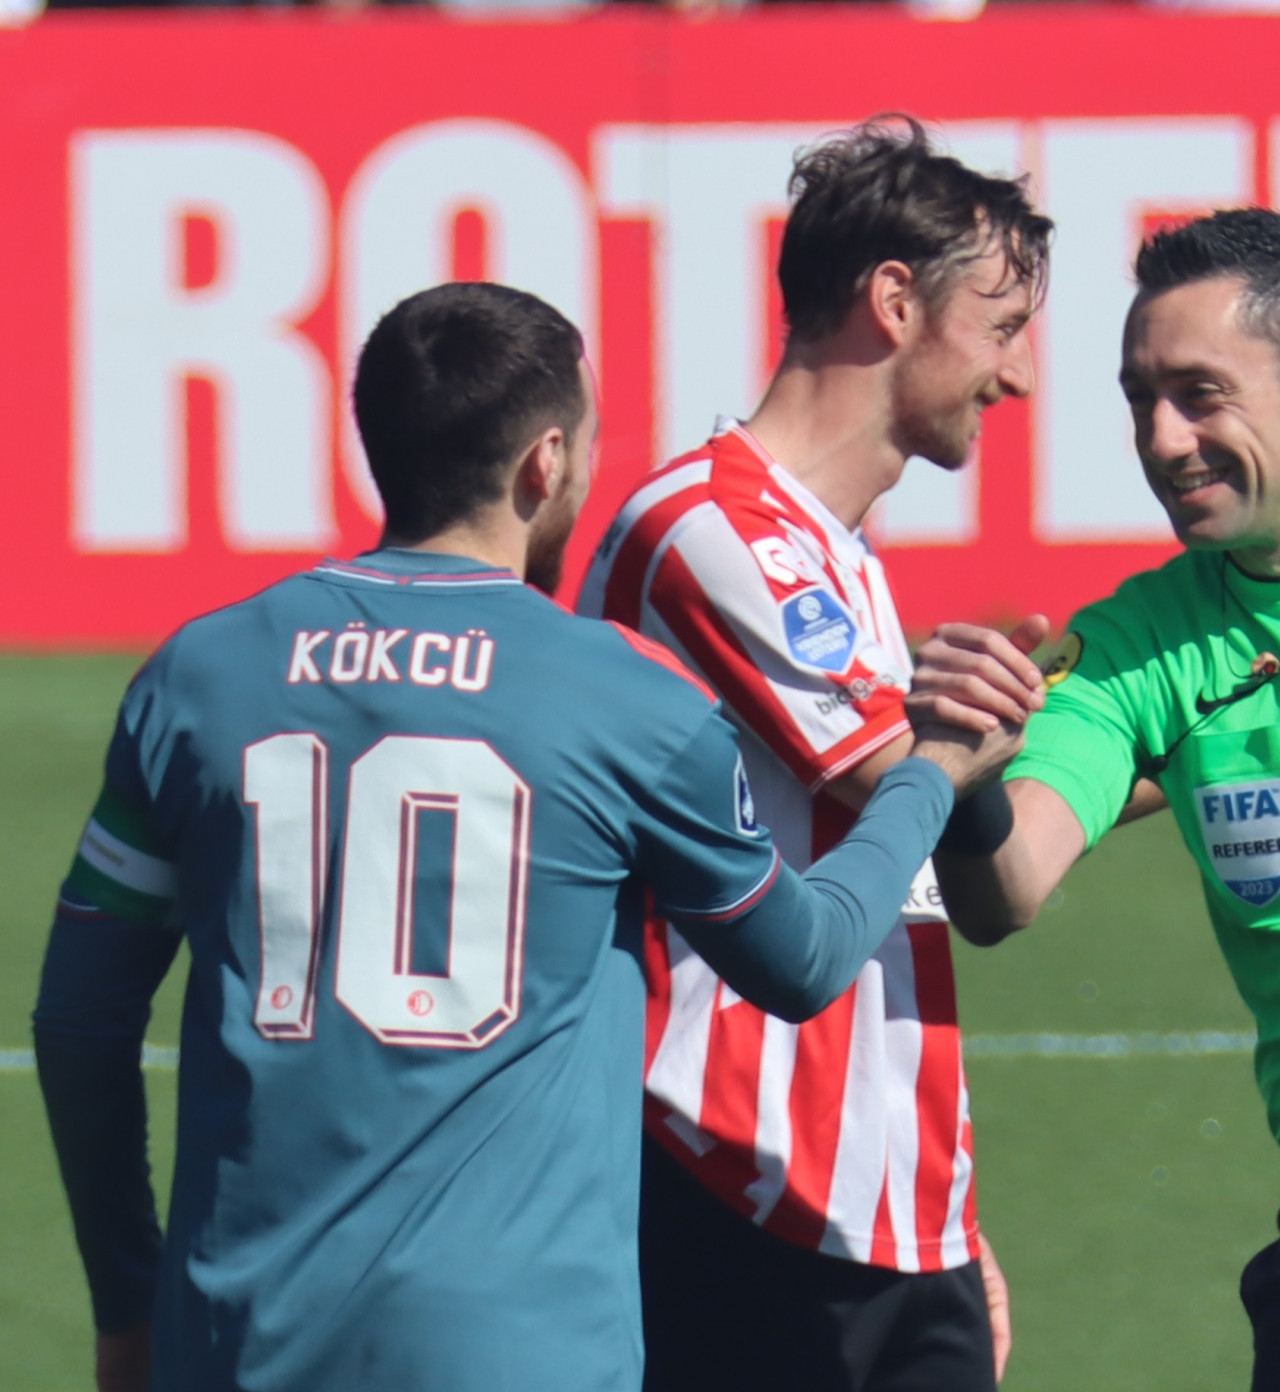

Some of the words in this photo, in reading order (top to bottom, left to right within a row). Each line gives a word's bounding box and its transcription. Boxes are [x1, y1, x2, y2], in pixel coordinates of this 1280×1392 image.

[287, 621, 495, 692] KÖKCÜ
[243, 731, 532, 1049] 10
[1239, 881, 1275, 897] 2023
